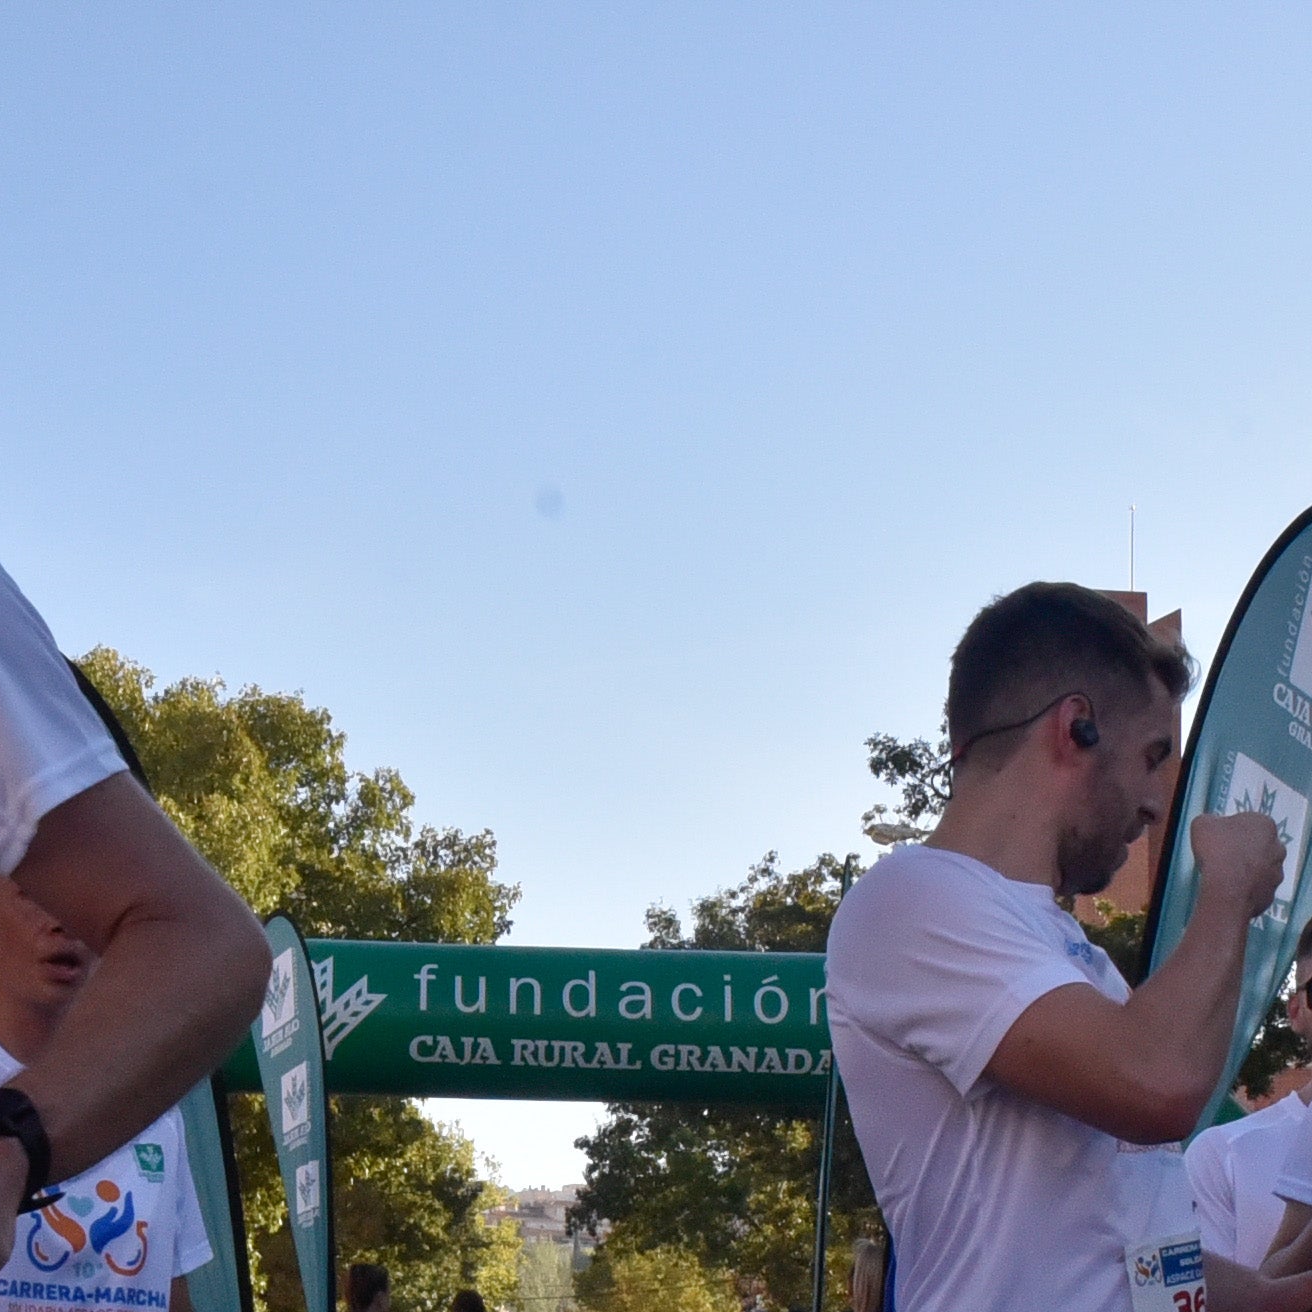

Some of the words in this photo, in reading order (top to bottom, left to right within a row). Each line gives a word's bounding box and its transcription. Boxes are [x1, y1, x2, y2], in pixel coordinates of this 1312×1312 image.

[1277, 555, 1312, 678] fundación
[1272, 683, 1312, 727] CAJA
[413, 963, 828, 1026] fundación
[408, 1034, 502, 1066] CAJA
[510, 1038, 642, 1071] RURAL
[649, 1043, 832, 1076] GRANADA
